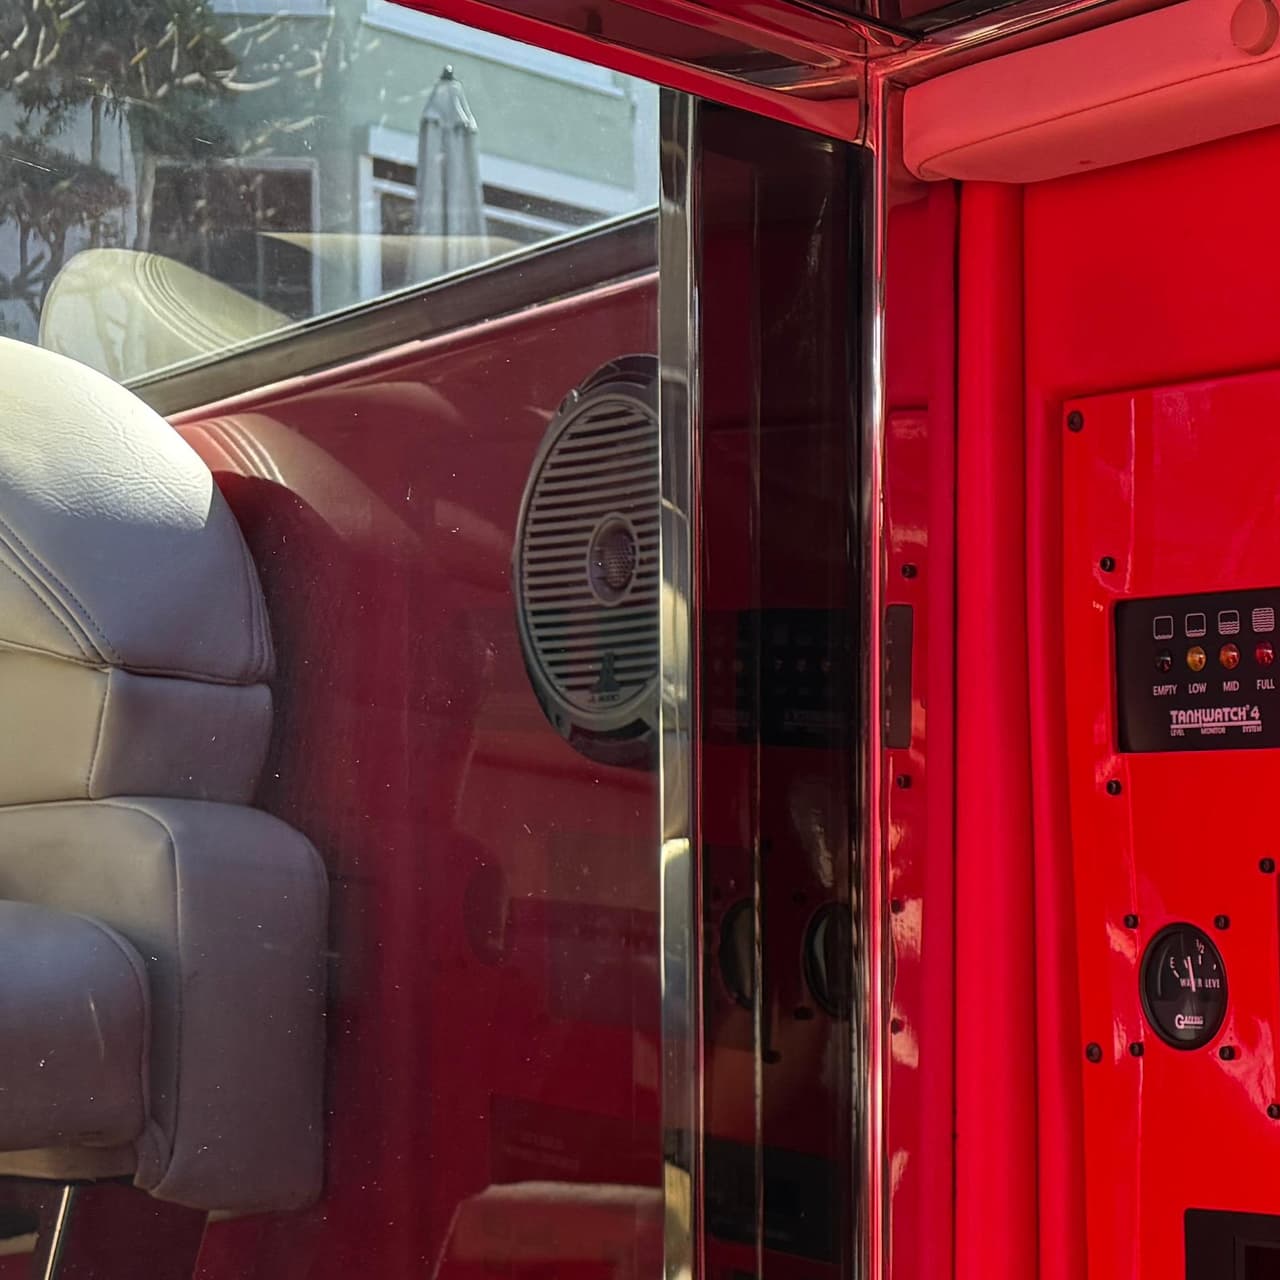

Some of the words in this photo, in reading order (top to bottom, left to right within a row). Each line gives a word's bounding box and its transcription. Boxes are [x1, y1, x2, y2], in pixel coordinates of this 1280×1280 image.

[1153, 684, 1177, 696] EMPTY
[1188, 683, 1207, 694] LOW
[1223, 681, 1239, 692] MID
[1256, 679, 1275, 690] FULL
[1250, 706, 1260, 720] 4
[1170, 956, 1175, 969] E
